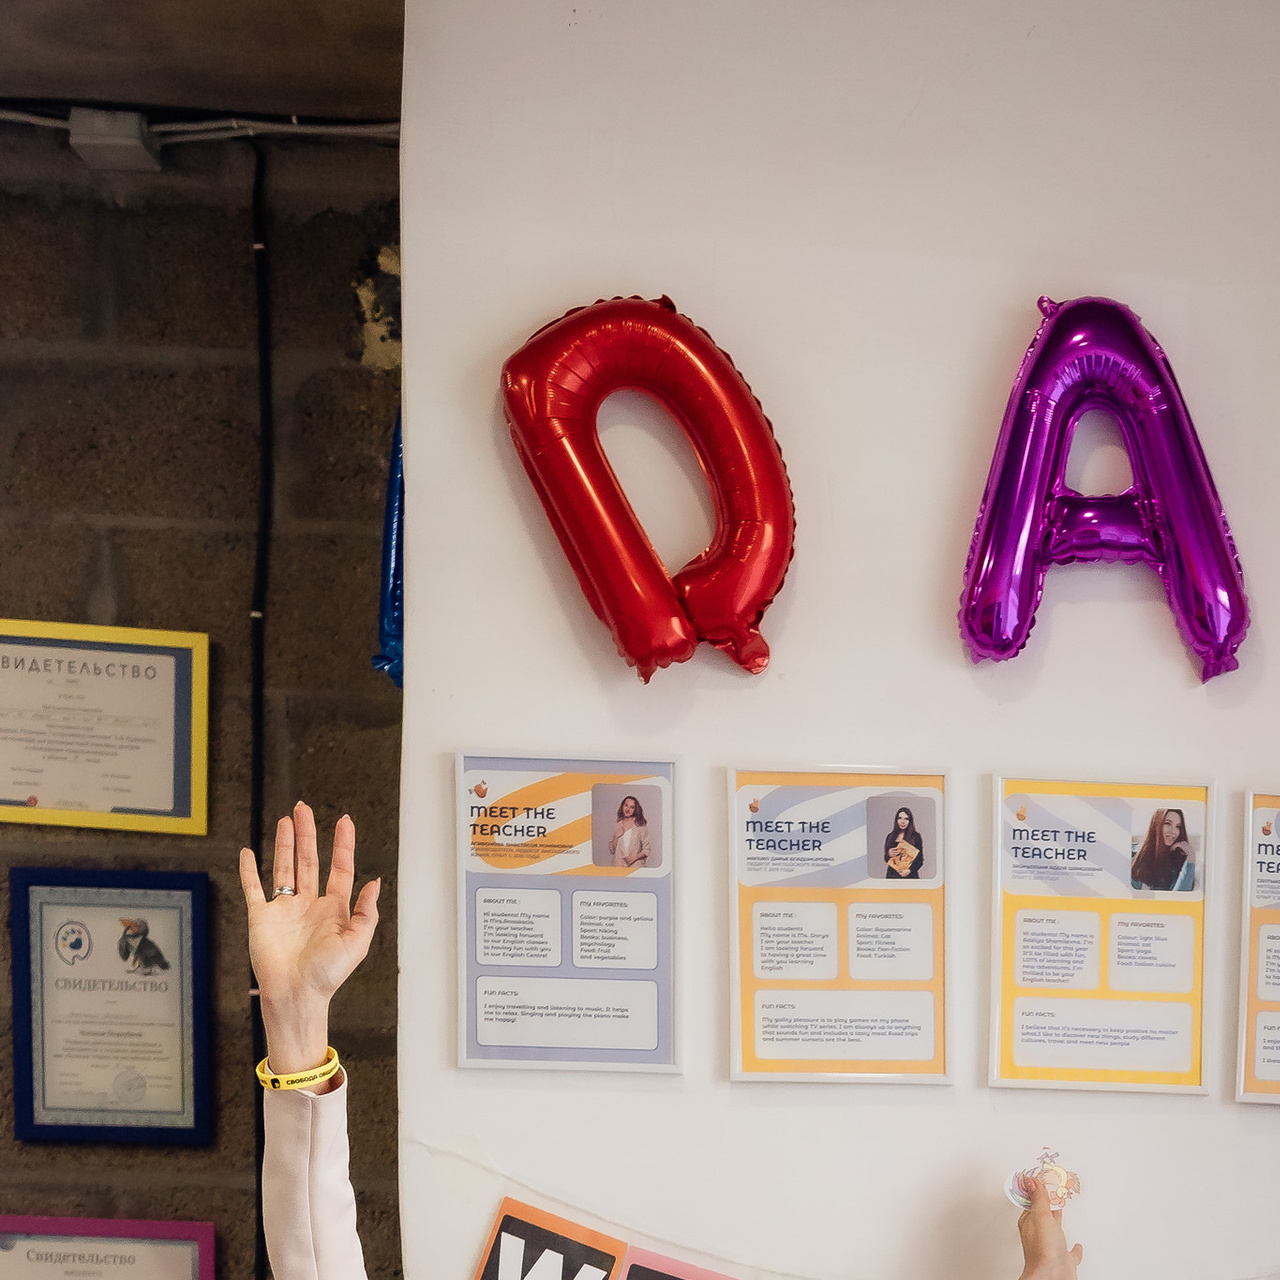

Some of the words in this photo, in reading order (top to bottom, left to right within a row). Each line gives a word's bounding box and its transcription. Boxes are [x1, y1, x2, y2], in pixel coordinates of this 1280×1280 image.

[1, 653, 158, 681] ВИДЕТЕЛЬСТВО
[470, 805, 519, 820] MEET
[523, 807, 556, 821] THE
[469, 823, 547, 838] TEACHER
[746, 820, 794, 834] MEET
[798, 820, 831, 834] THE
[1012, 828, 1060, 843] MEET
[1065, 829, 1096, 844] THE
[746, 838, 822, 852] TEACHER
[1011, 846, 1087, 861] TEACHER
